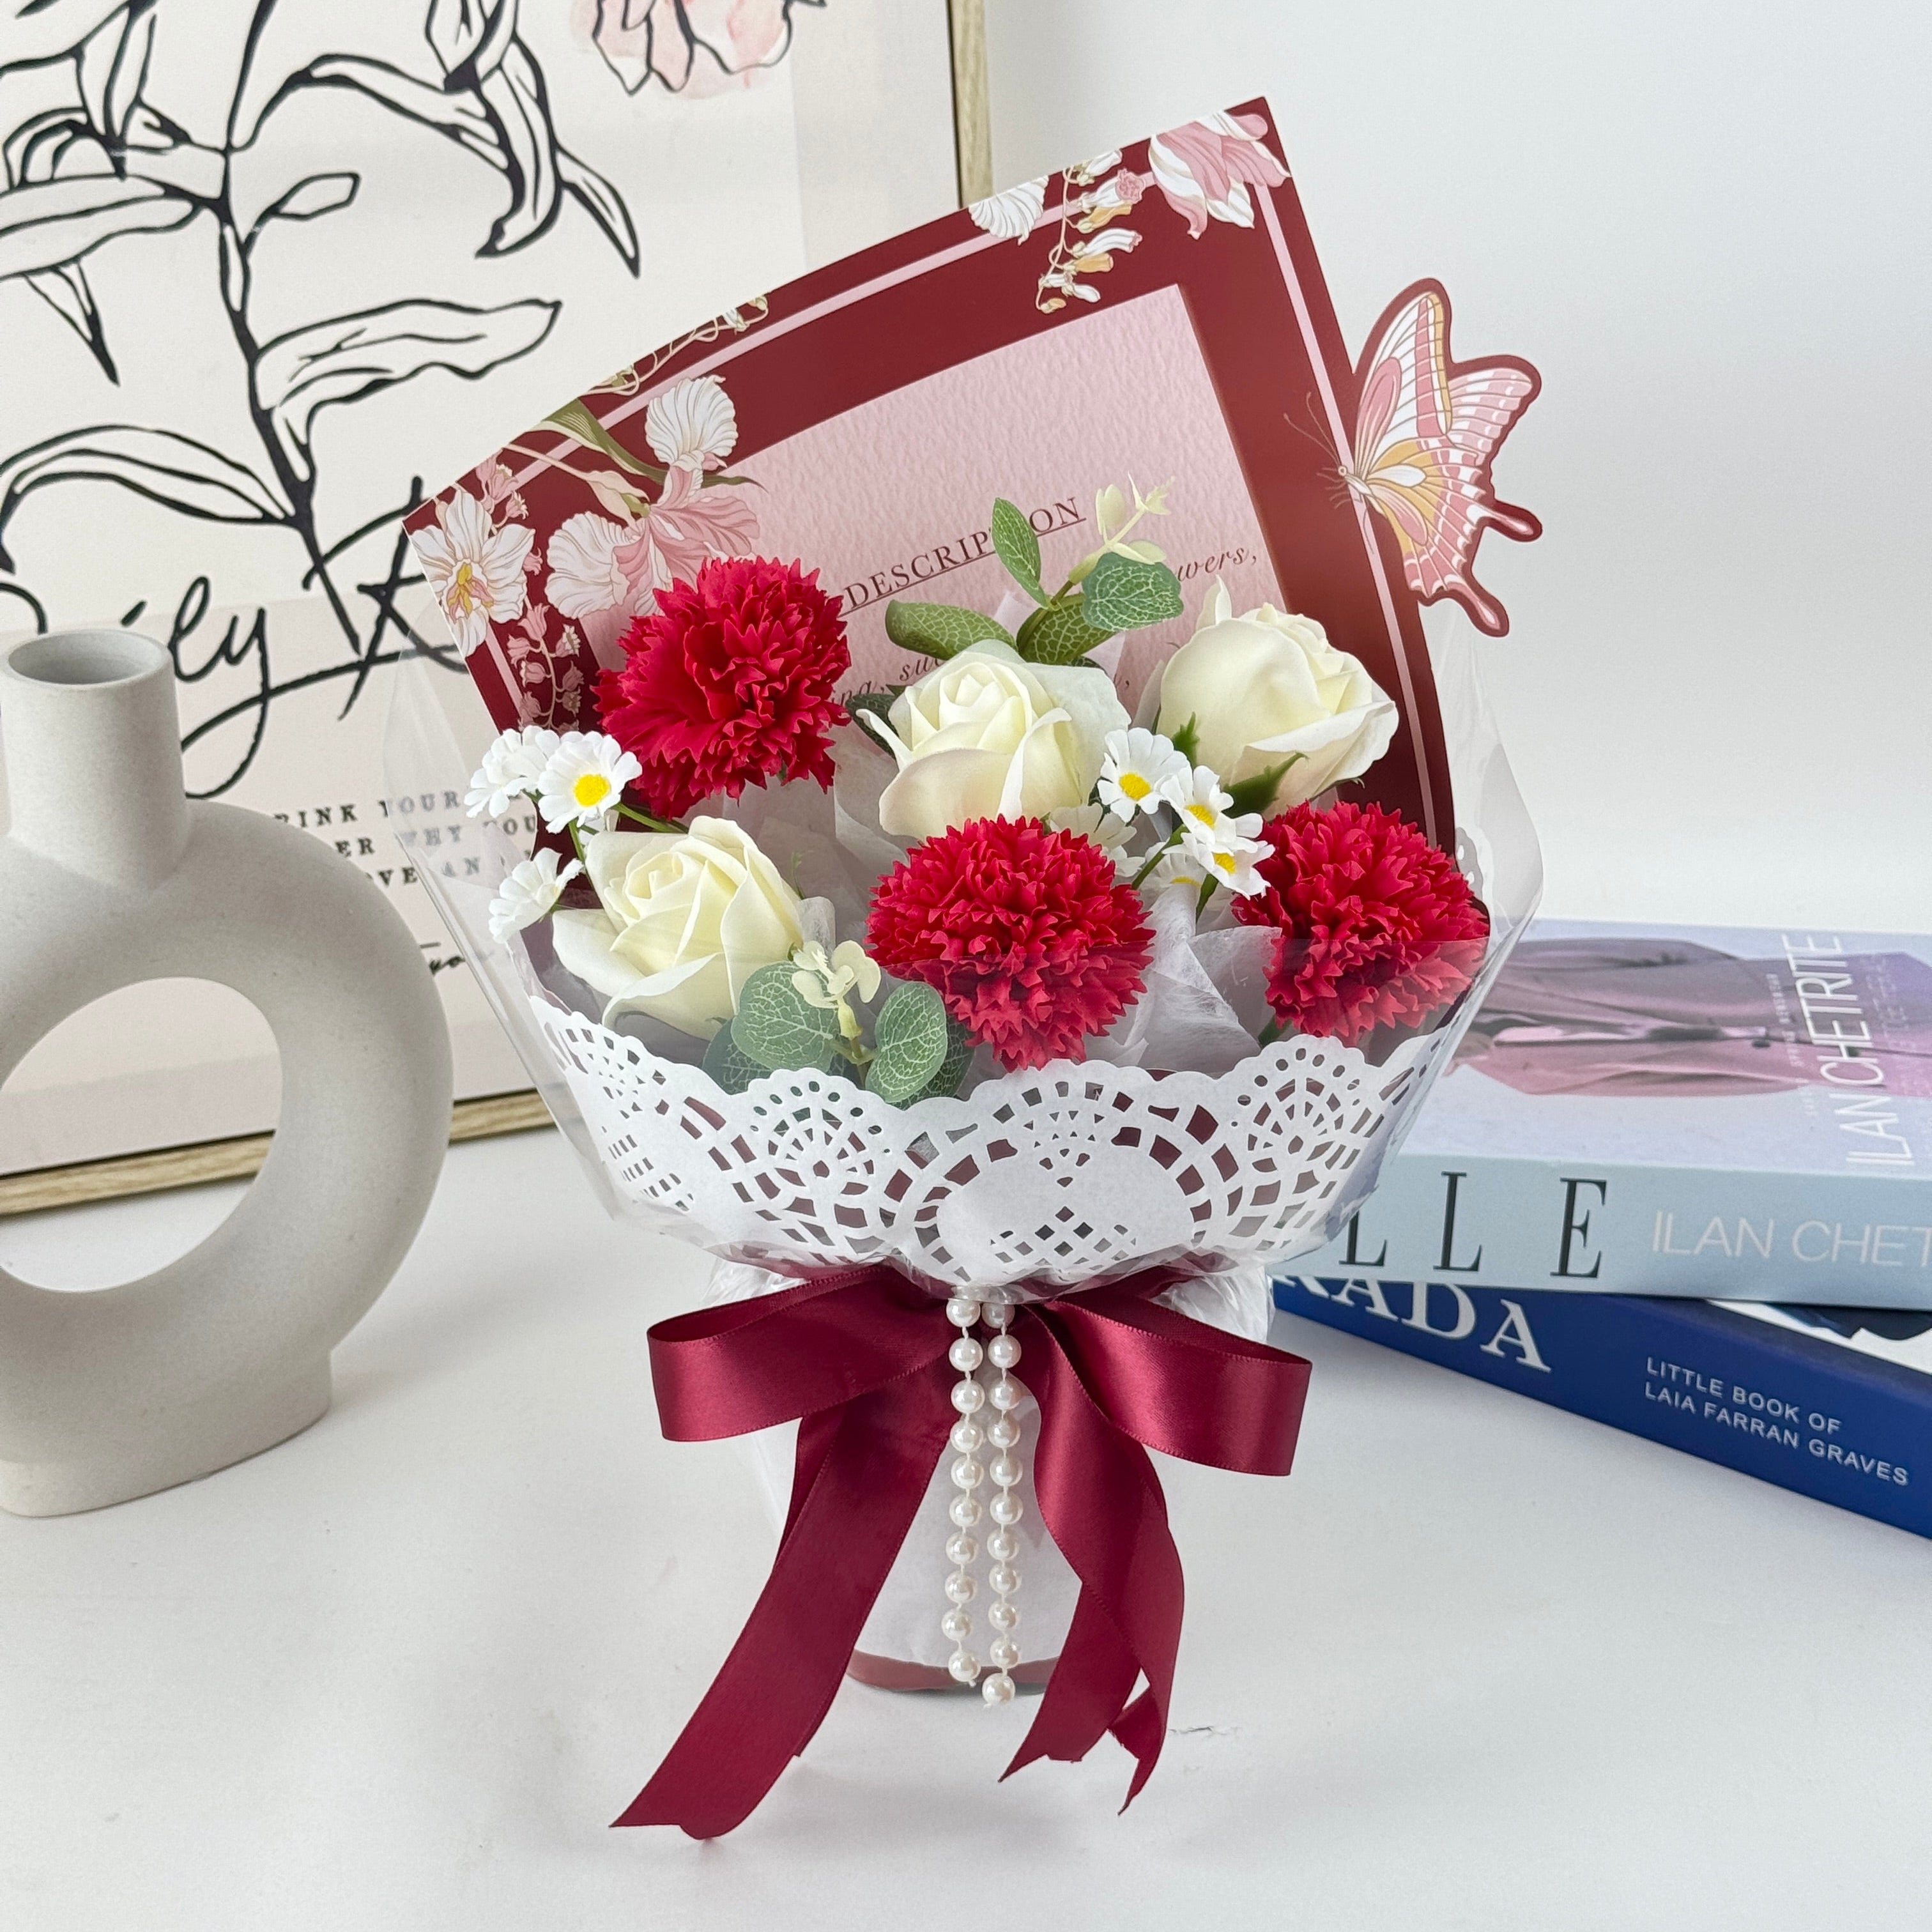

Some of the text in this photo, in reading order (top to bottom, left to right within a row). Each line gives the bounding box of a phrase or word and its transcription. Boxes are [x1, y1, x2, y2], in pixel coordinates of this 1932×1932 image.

[843, 496, 1082, 609] DESCRIPON
[1653, 1211, 1775, 1259] ILAN
[1644, 1381, 1910, 1487] LAIA FARRAN GRAVES
[1646, 1356, 1843, 1434] LITTLE BOOK OF
